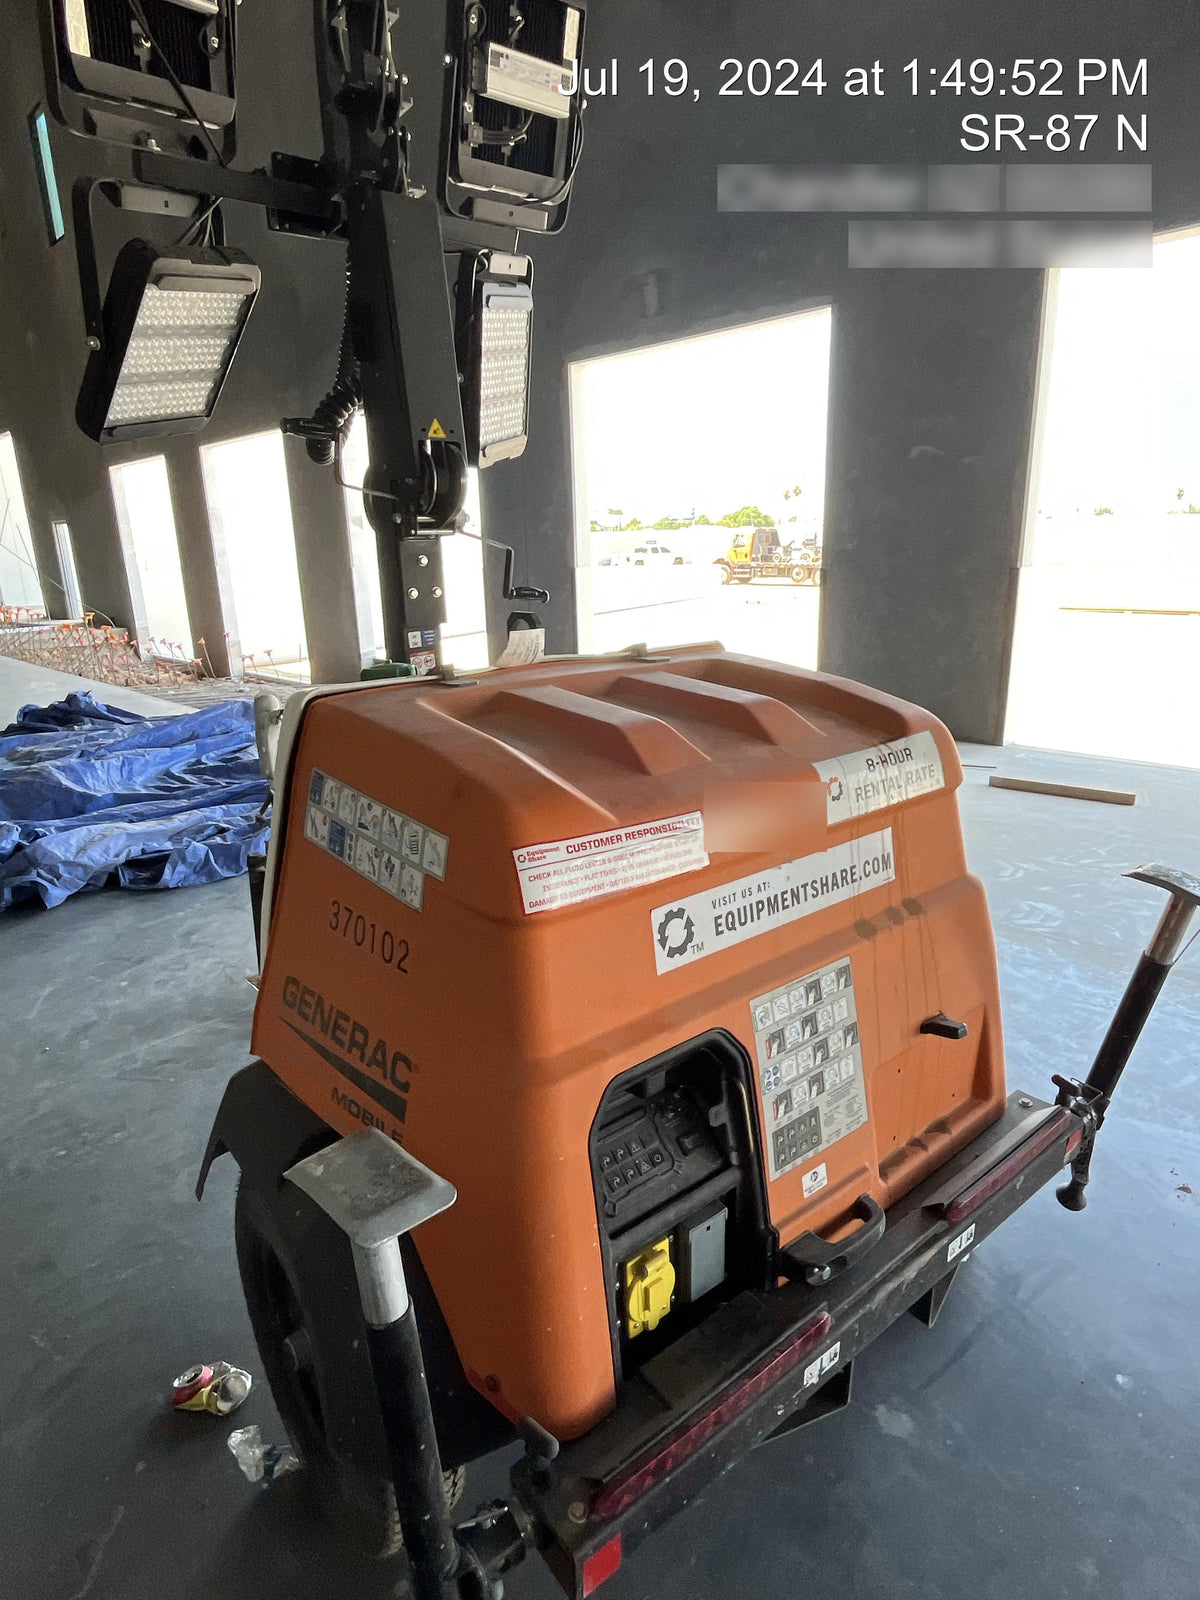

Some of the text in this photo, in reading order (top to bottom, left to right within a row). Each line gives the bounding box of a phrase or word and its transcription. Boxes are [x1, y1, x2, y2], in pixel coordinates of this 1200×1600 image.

[866, 747, 914, 773] 8-HOUR
[854, 763, 936, 803] RENTAL RATE
[526, 845, 559, 857] Equipment
[566, 833, 623, 855] CUSTOMER
[527, 854, 546, 862] Share
[528, 870, 551, 882] CHECK
[711, 881, 770, 909] VISIT US AT:
[713, 851, 892, 937] EQUIPMENTSHARE.COM
[329, 900, 409, 974] 370102
[282, 975, 412, 1094] GENERAC
